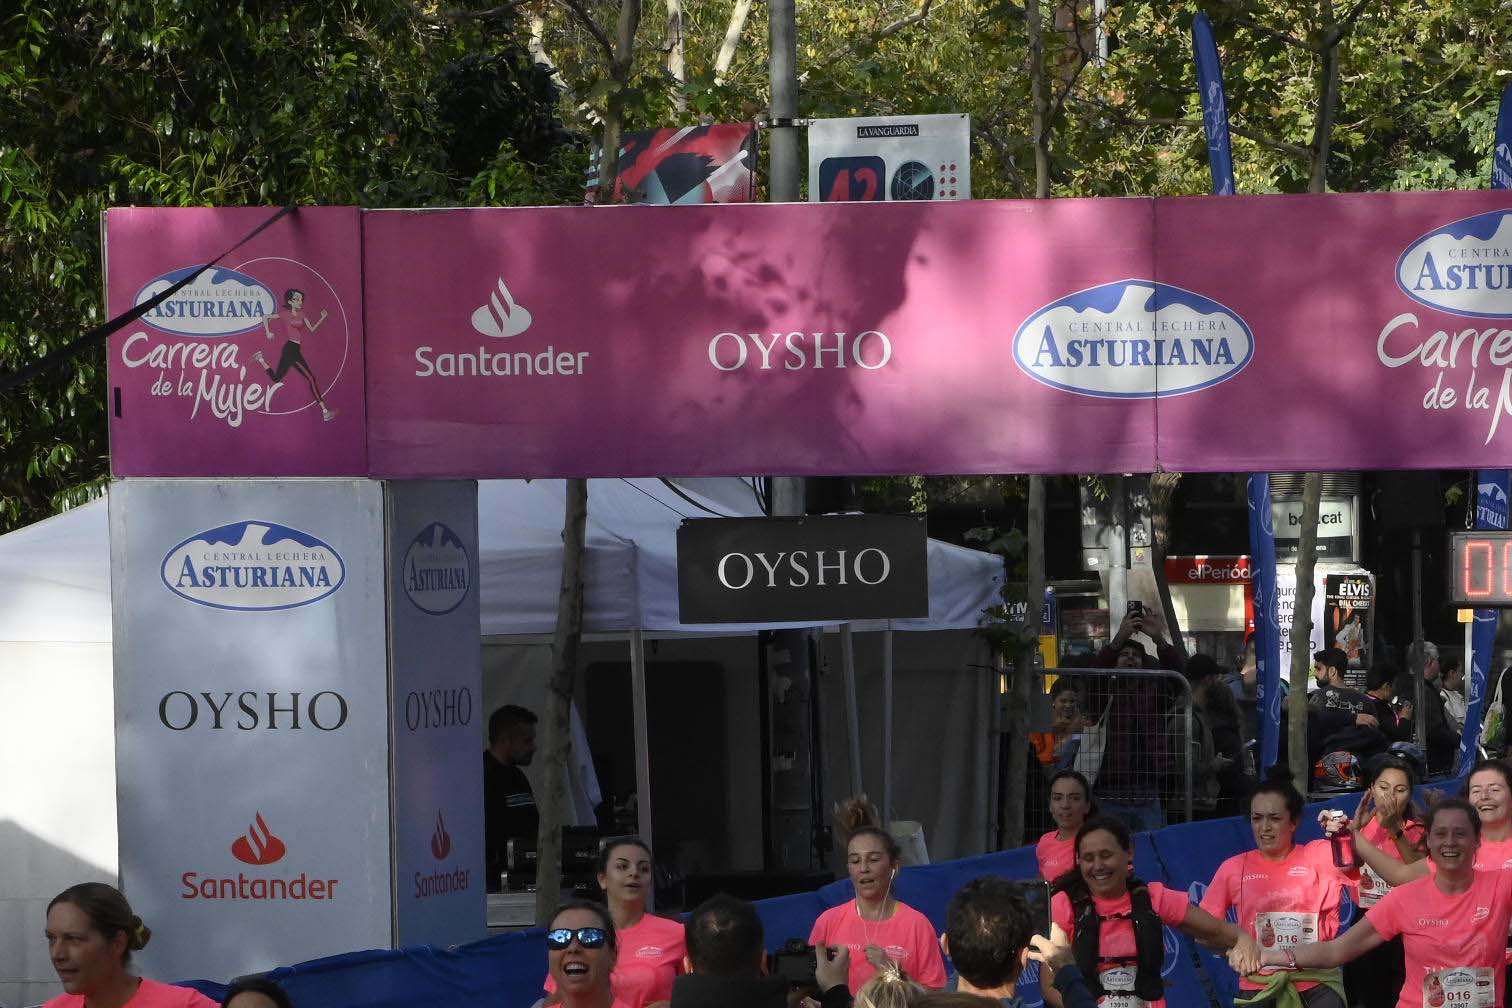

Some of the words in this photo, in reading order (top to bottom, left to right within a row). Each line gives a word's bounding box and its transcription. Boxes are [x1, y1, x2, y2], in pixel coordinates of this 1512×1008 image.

[143, 288, 267, 319] ASTURIANA
[1068, 320, 1144, 334] CENTRAL
[1151, 320, 1228, 333] LECHERA
[121, 332, 240, 370] Carrera
[415, 346, 590, 378] Santander
[708, 330, 891, 371] OYSHO
[1031, 323, 1235, 369] ASTURIANA
[151, 372, 174, 398] de
[178, 371, 193, 397] la
[191, 364, 284, 428] Mujer
[1423, 375, 1457, 410] de
[1466, 371, 1490, 410] la
[175, 554, 332, 588] ASTURIANA
[204, 553, 262, 562] CENTRAL
[267, 552, 326, 561] LECHERA
[718, 548, 891, 590] OYSHO
[408, 557, 467, 592] ASTURIANA
[1339, 583, 1370, 597] ELVIS
[158, 691, 348, 731] OYSHO
[406, 687, 471, 731] OYSHO
[182, 872, 338, 900] Santander
[415, 868, 470, 899] Santander
[1418, 917, 1449, 927] OYSHO
[1276, 934, 1298, 943] 016
[1446, 990, 1471, 1002] 016
